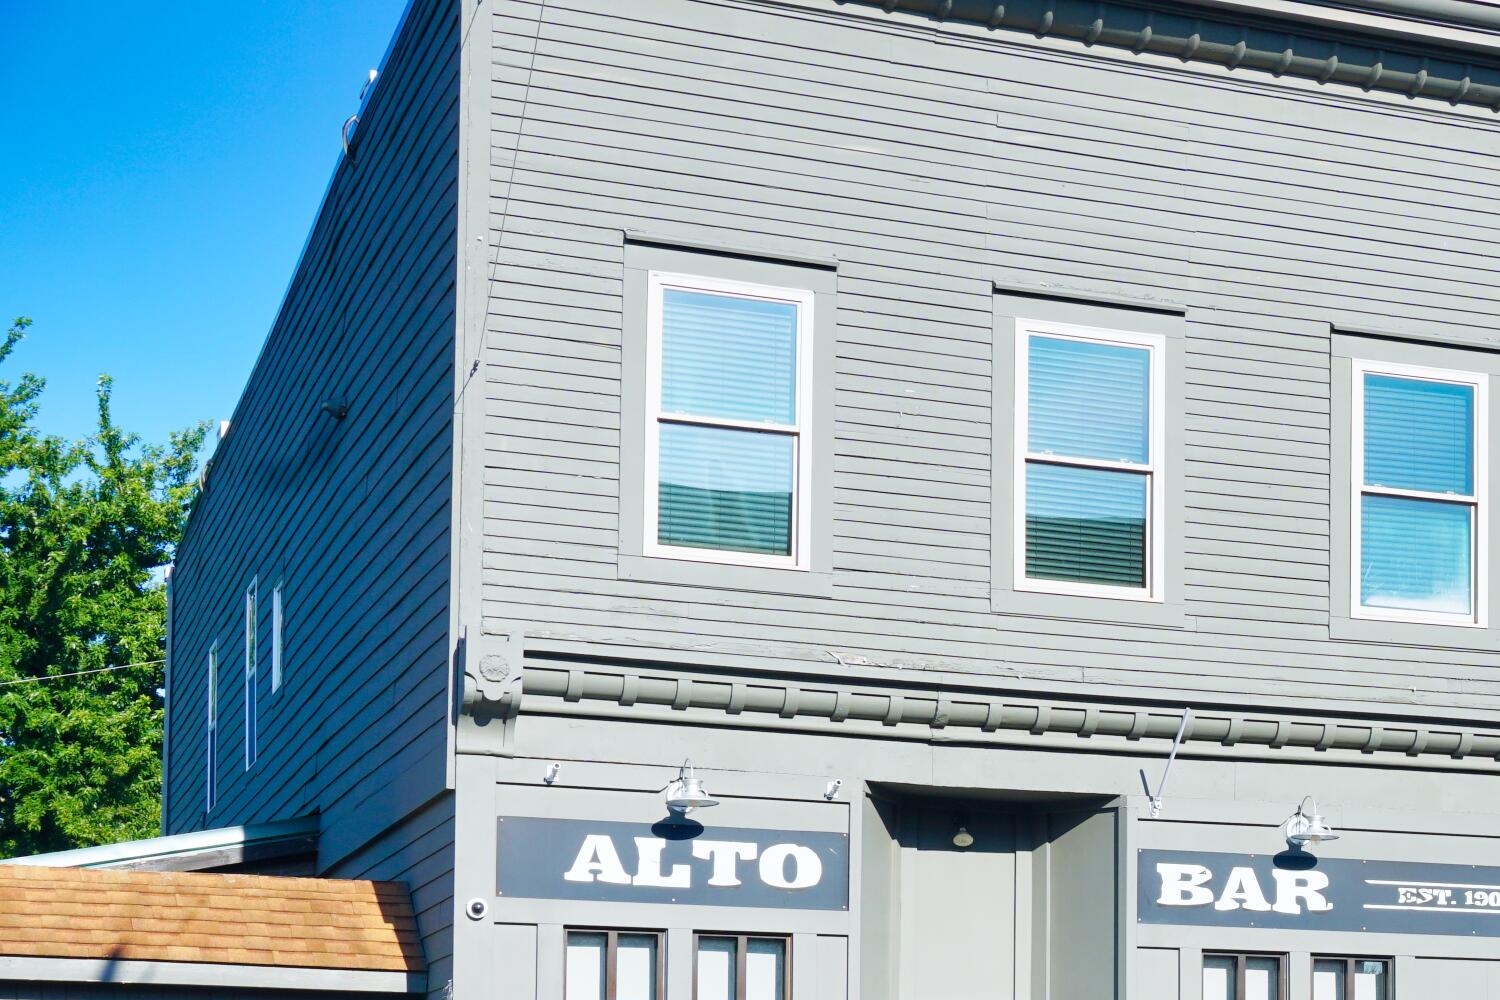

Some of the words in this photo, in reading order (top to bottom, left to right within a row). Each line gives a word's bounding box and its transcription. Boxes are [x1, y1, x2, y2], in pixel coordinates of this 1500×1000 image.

[563, 834, 823, 889] ALTO
[1156, 862, 1334, 915] BAR
[1397, 887, 1456, 906] EST.
